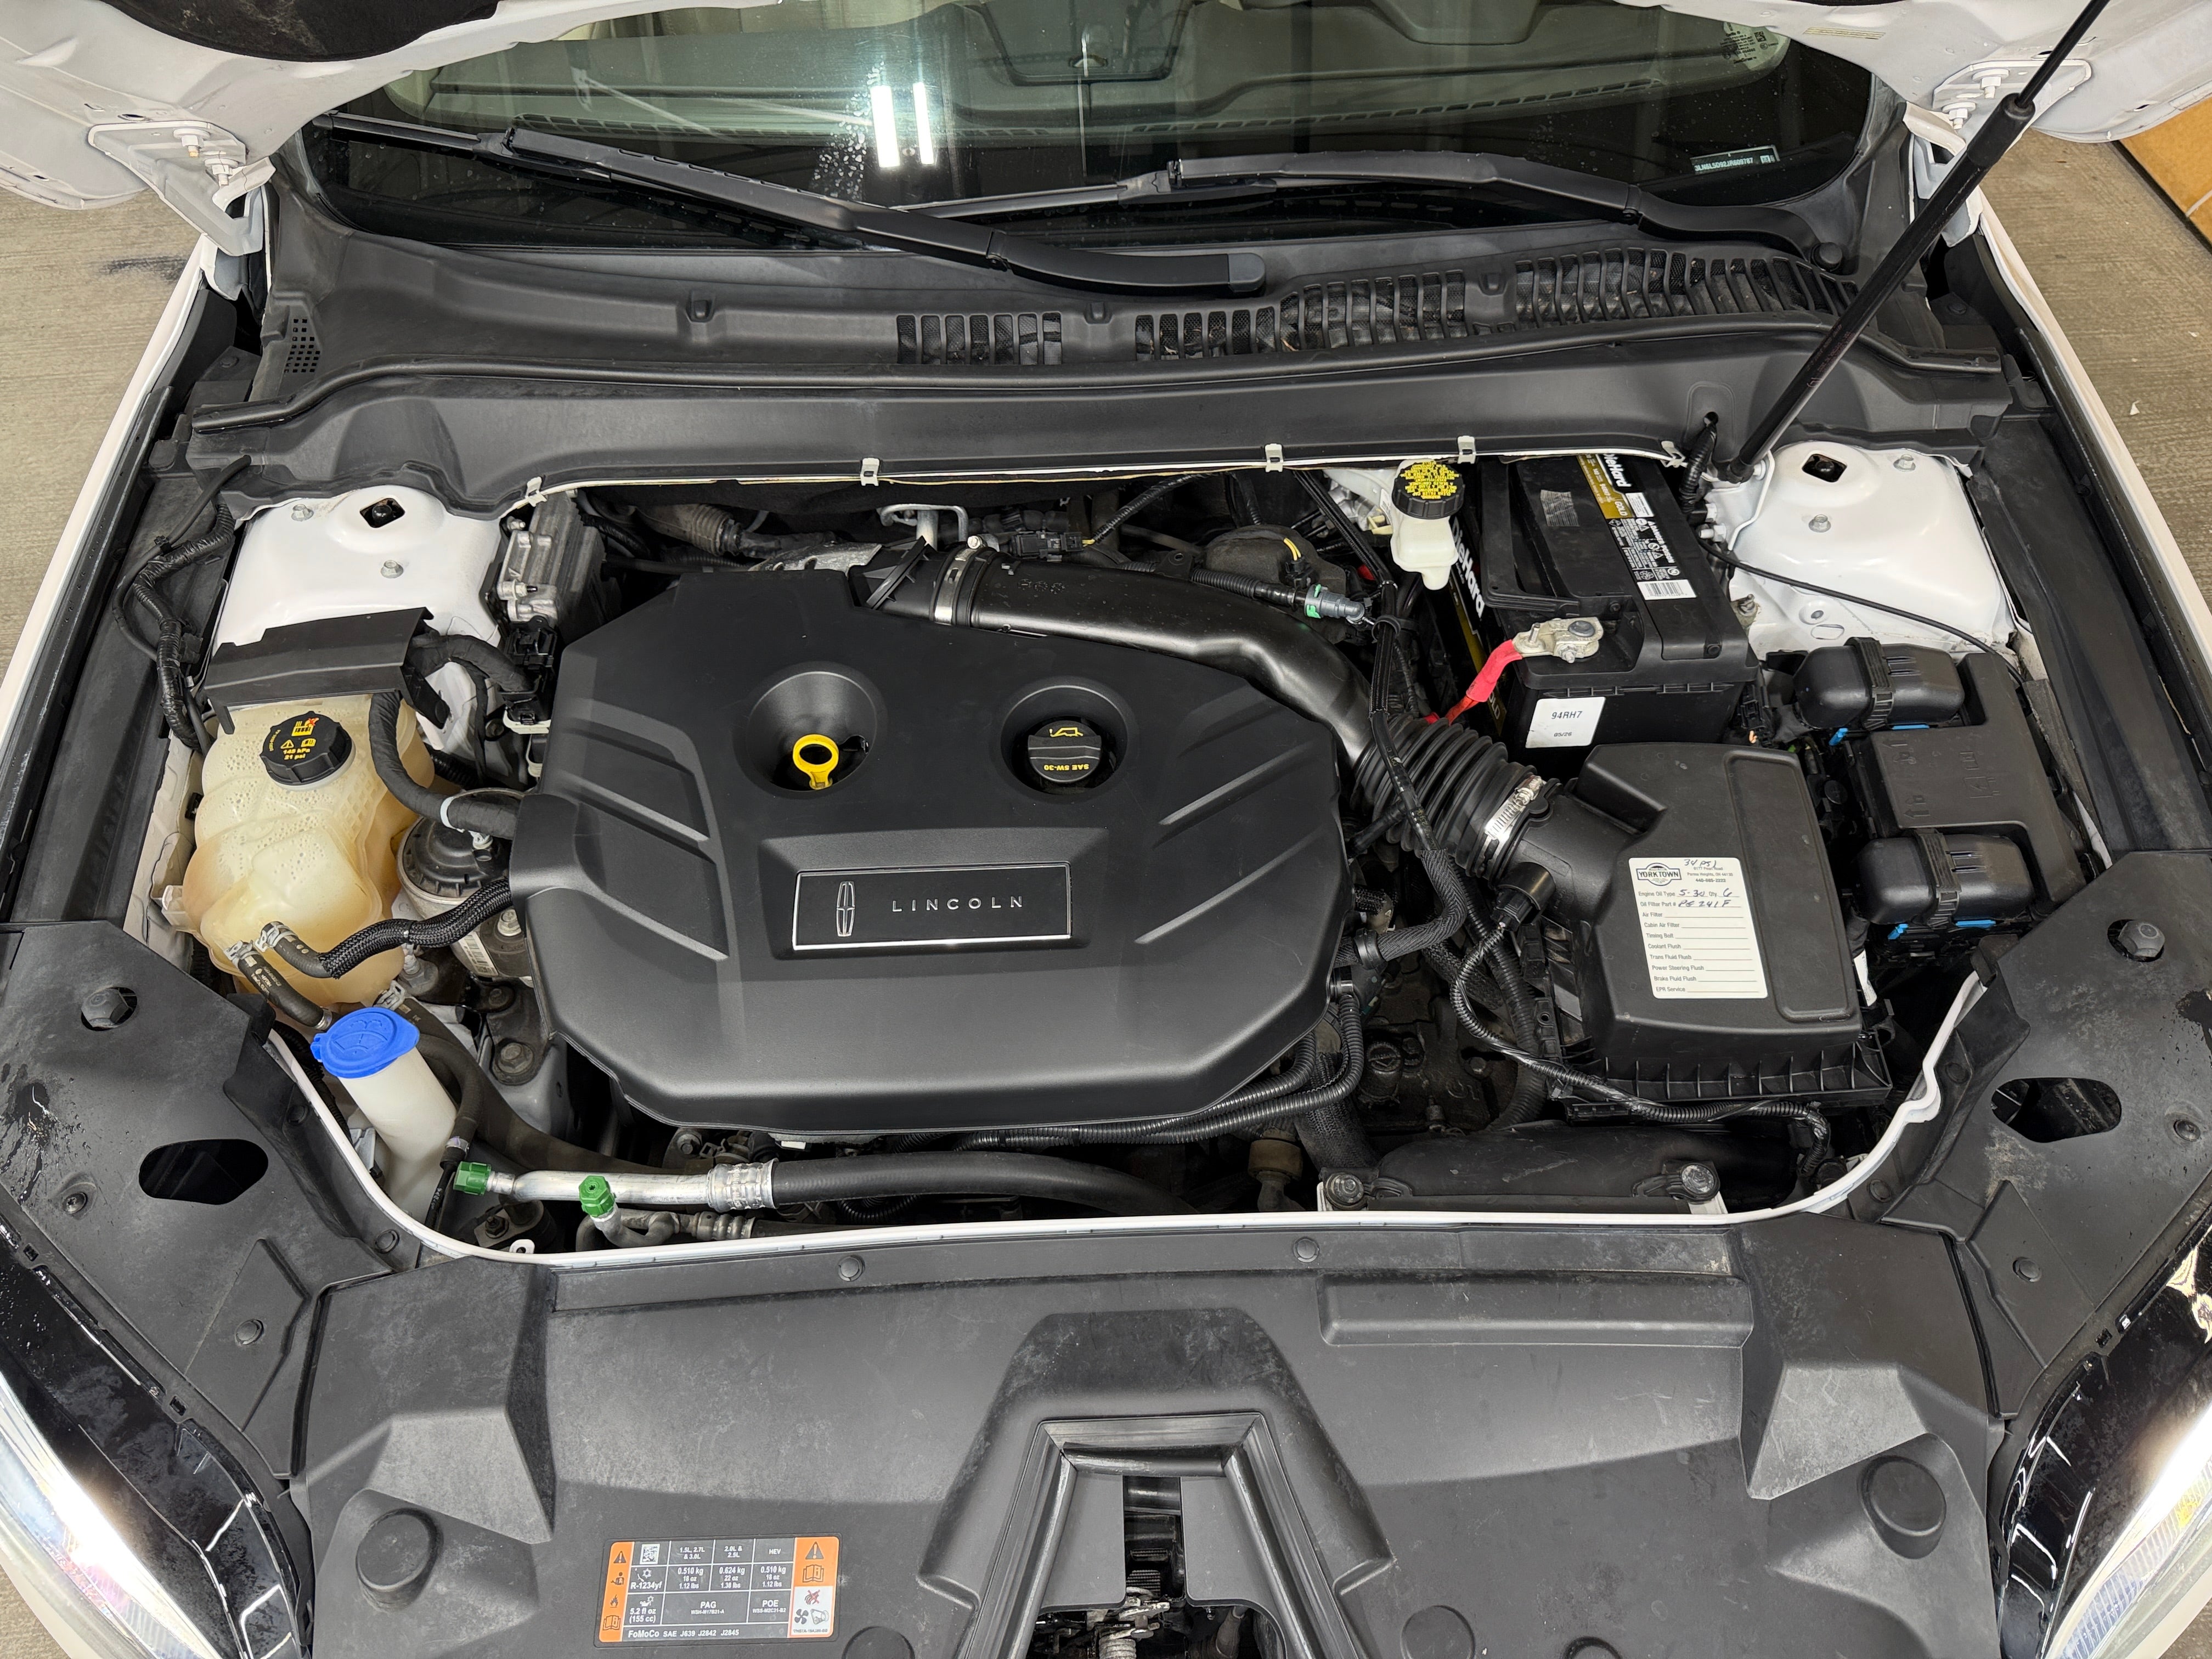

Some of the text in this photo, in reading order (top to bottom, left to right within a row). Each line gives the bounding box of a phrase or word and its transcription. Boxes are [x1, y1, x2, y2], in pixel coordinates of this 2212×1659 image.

[1615, 501, 1628, 516] GOLD
[1488, 692, 1501, 720] OLD
[1551, 711, 1583, 719] 94RH7
[892, 895, 1023, 912] LINCOLN
[694, 1567, 704, 1577] kg
[736, 1566, 746, 1576] kg
[777, 1566, 787, 1575] kg
[630, 1581, 662, 1590] R-1234yf
[700, 1600, 716, 1609] PAG
[644, 1615, 656, 1623] cc)
[628, 1630, 660, 1638] FoMoCo
